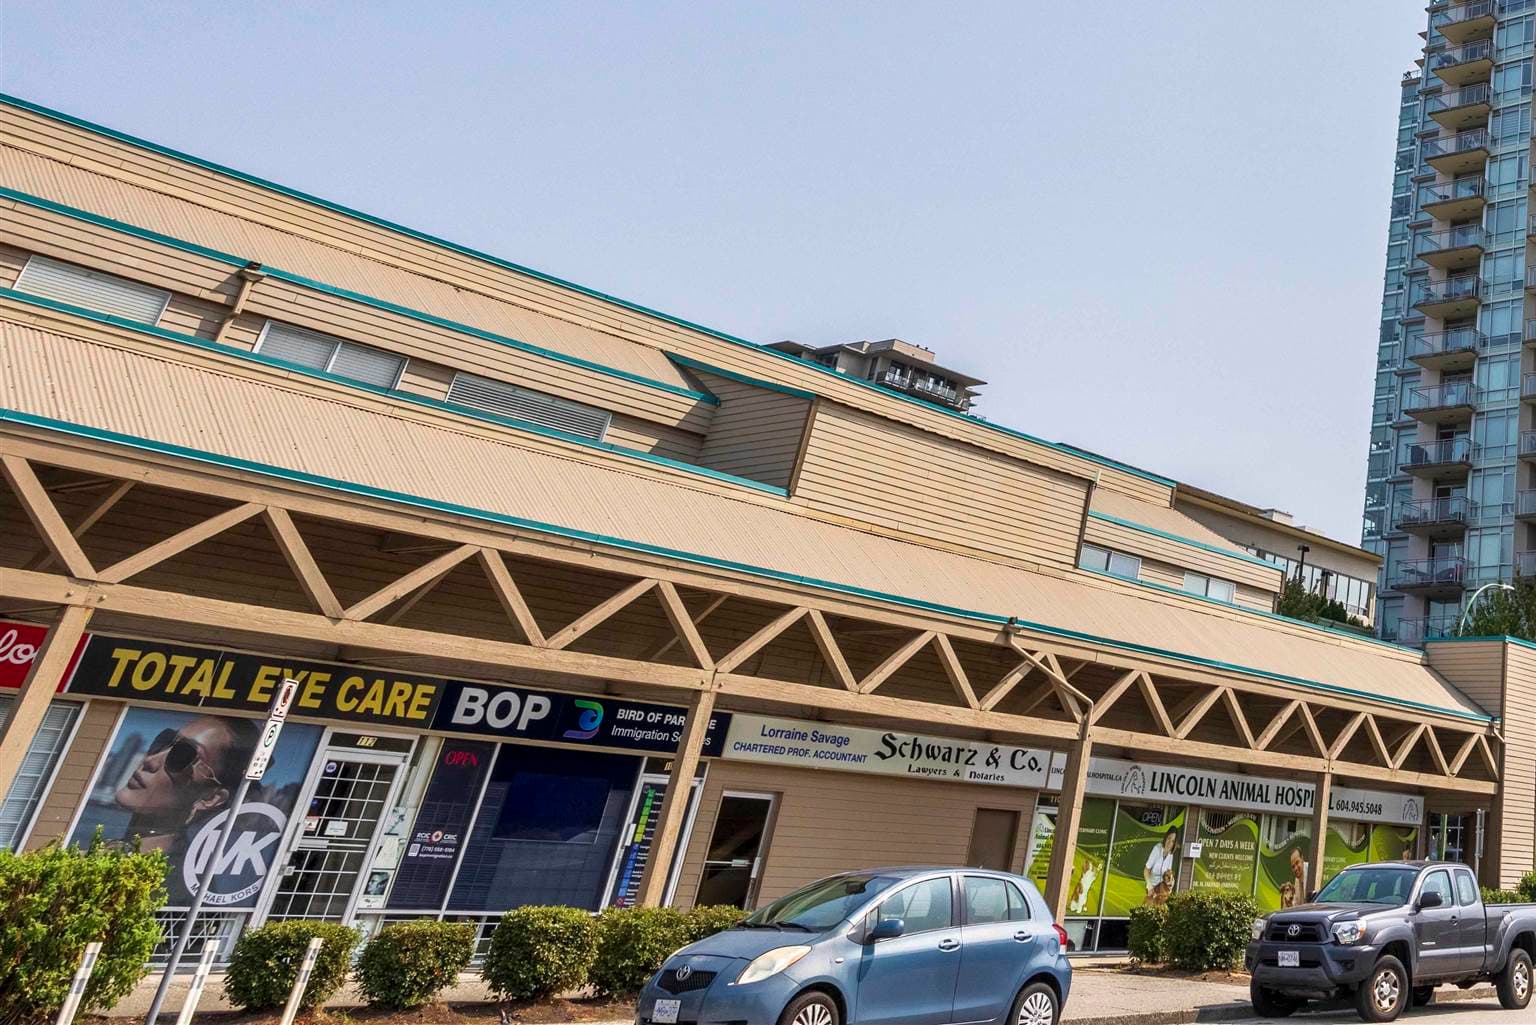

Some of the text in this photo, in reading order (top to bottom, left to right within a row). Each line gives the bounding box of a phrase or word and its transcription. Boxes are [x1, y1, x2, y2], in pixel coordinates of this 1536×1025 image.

[107, 648, 436, 720] TOTAL EYE CARE
[451, 687, 551, 730] BOP
[616, 709, 644, 722] BIRD
[647, 712, 662, 724] OF
[611, 724, 670, 742] Immigration
[760, 725, 850, 748] Lorraine Savage
[444, 751, 479, 767] OPEN
[733, 741, 868, 763] CHARTERED PROF. ACCOUNTANT
[874, 733, 1042, 773] Schwarz & Co.
[908, 764, 1005, 782] Lawyers & Notaries
[1150, 771, 1382, 816] LINCOLN ANIMAL HOSPIL 604.945.5048
[1220, 839, 1234, 849] DAYS
[1240, 841, 1255, 850] WEEK
[191, 883, 259, 903] MHAEL KORS
